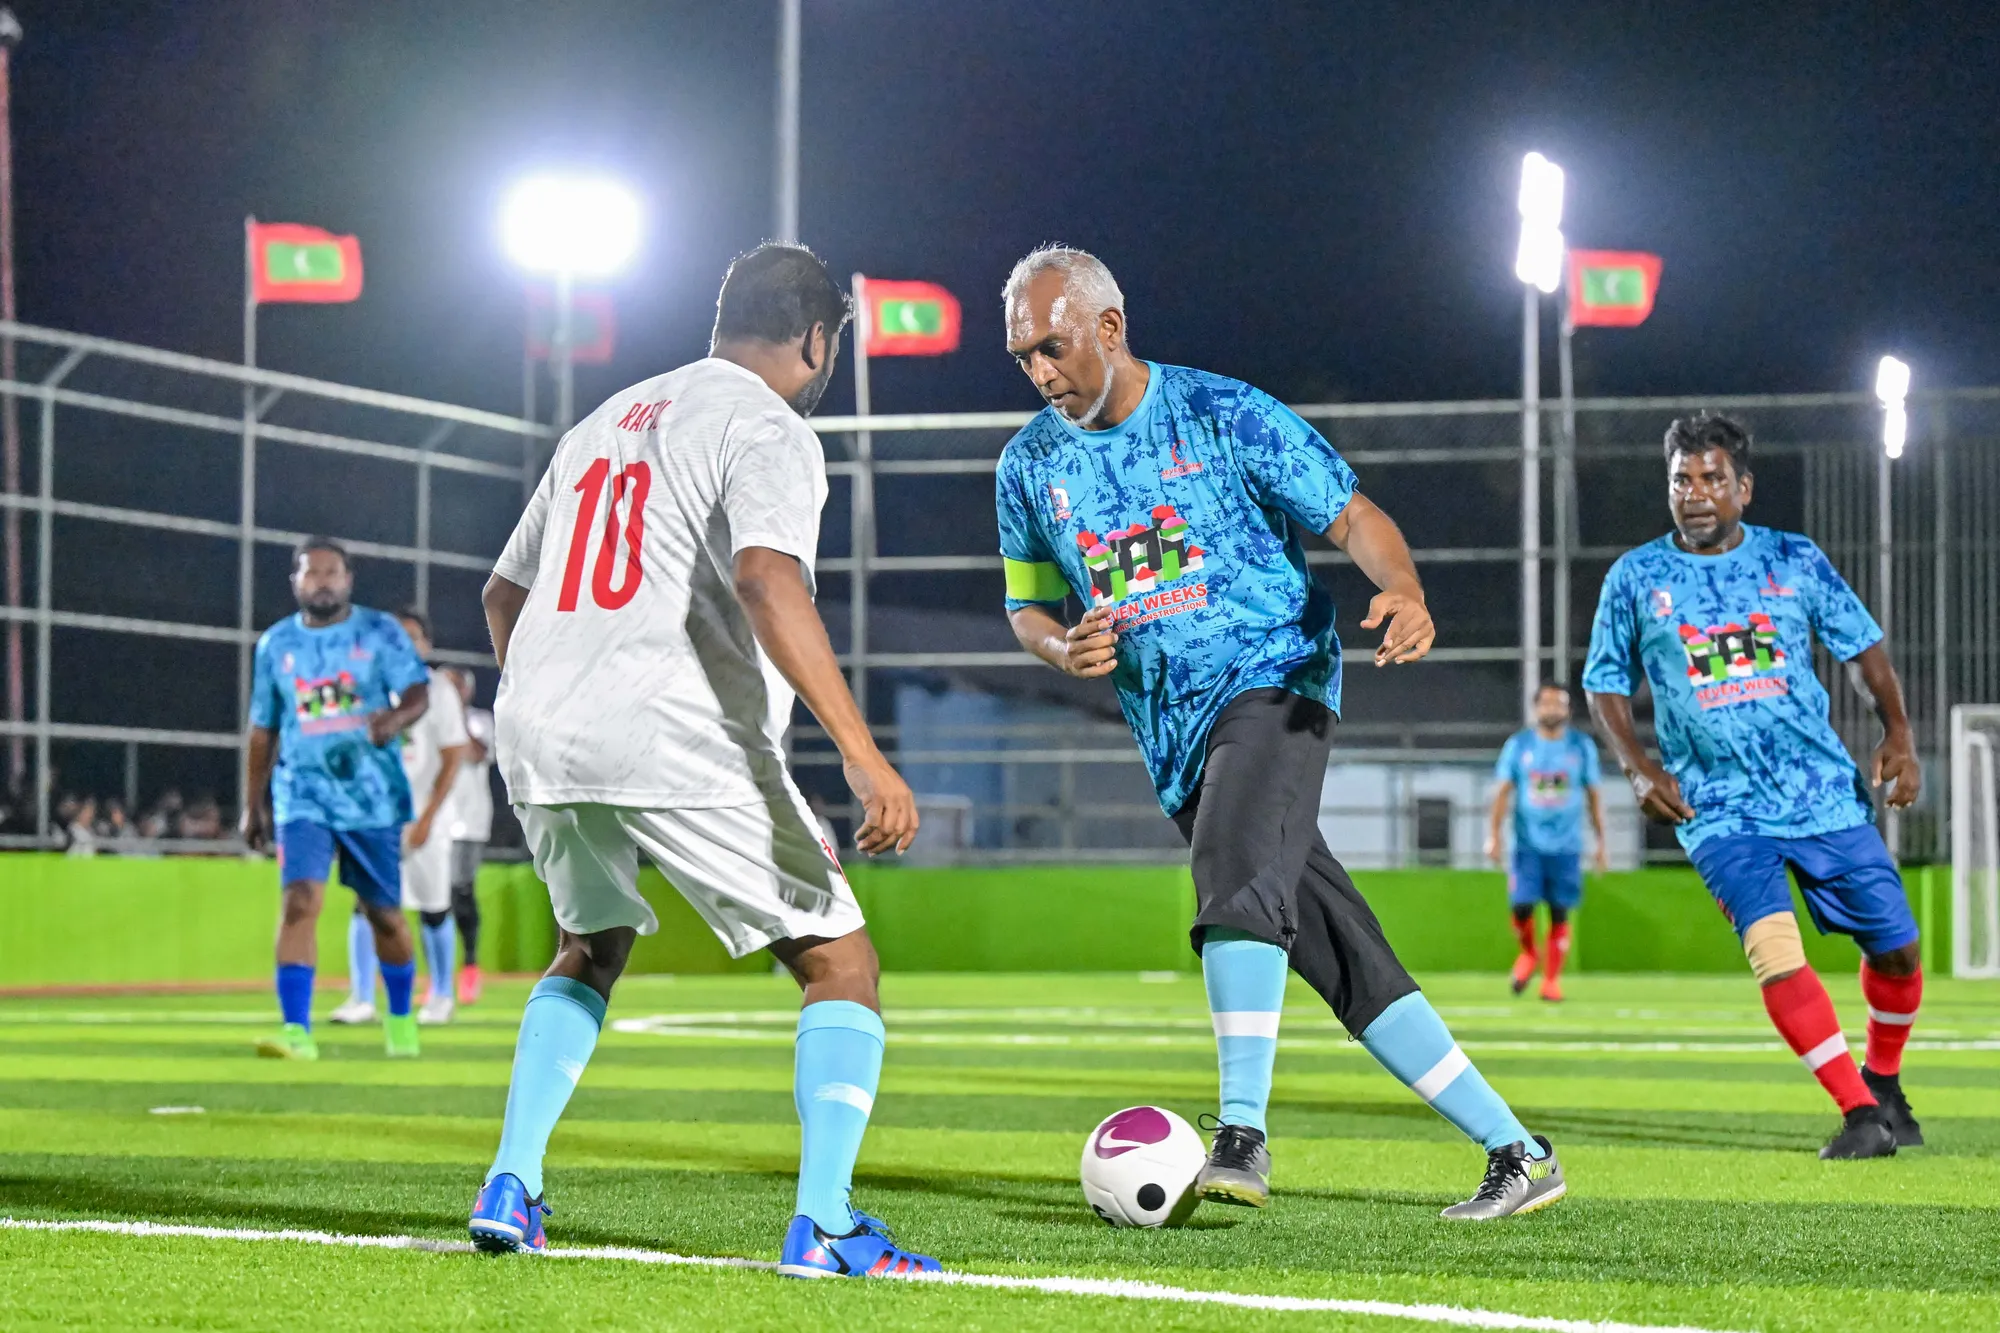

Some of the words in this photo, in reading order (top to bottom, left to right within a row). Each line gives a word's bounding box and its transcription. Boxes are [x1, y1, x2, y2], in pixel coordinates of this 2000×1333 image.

[557, 457, 651, 612] 10
[1105, 601, 1139, 626] EVEN
[1143, 583, 1207, 611] WEEKS
[1131, 599, 1207, 627] &CONSTRUCTIONS
[1696, 683, 1740, 701] SEVEN
